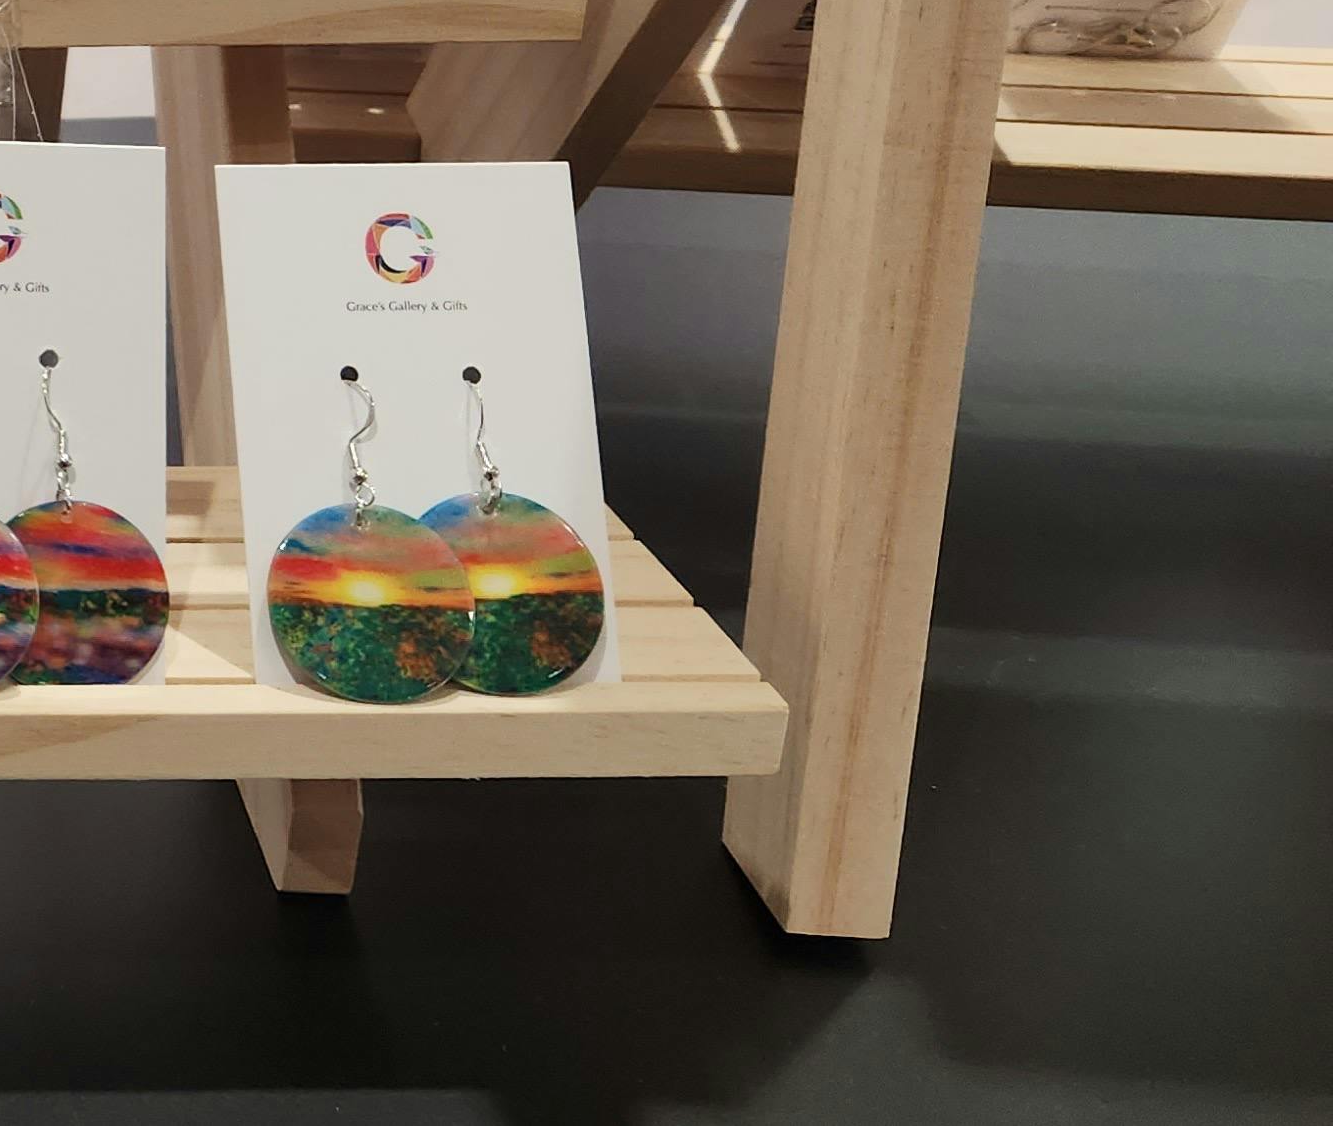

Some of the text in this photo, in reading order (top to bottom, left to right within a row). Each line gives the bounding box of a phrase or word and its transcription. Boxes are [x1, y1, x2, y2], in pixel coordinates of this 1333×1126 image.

[13, 282, 21, 292] &
[25, 282, 50, 293] Gifts
[346, 300, 468, 313] Grace's Gallery & Gifts
